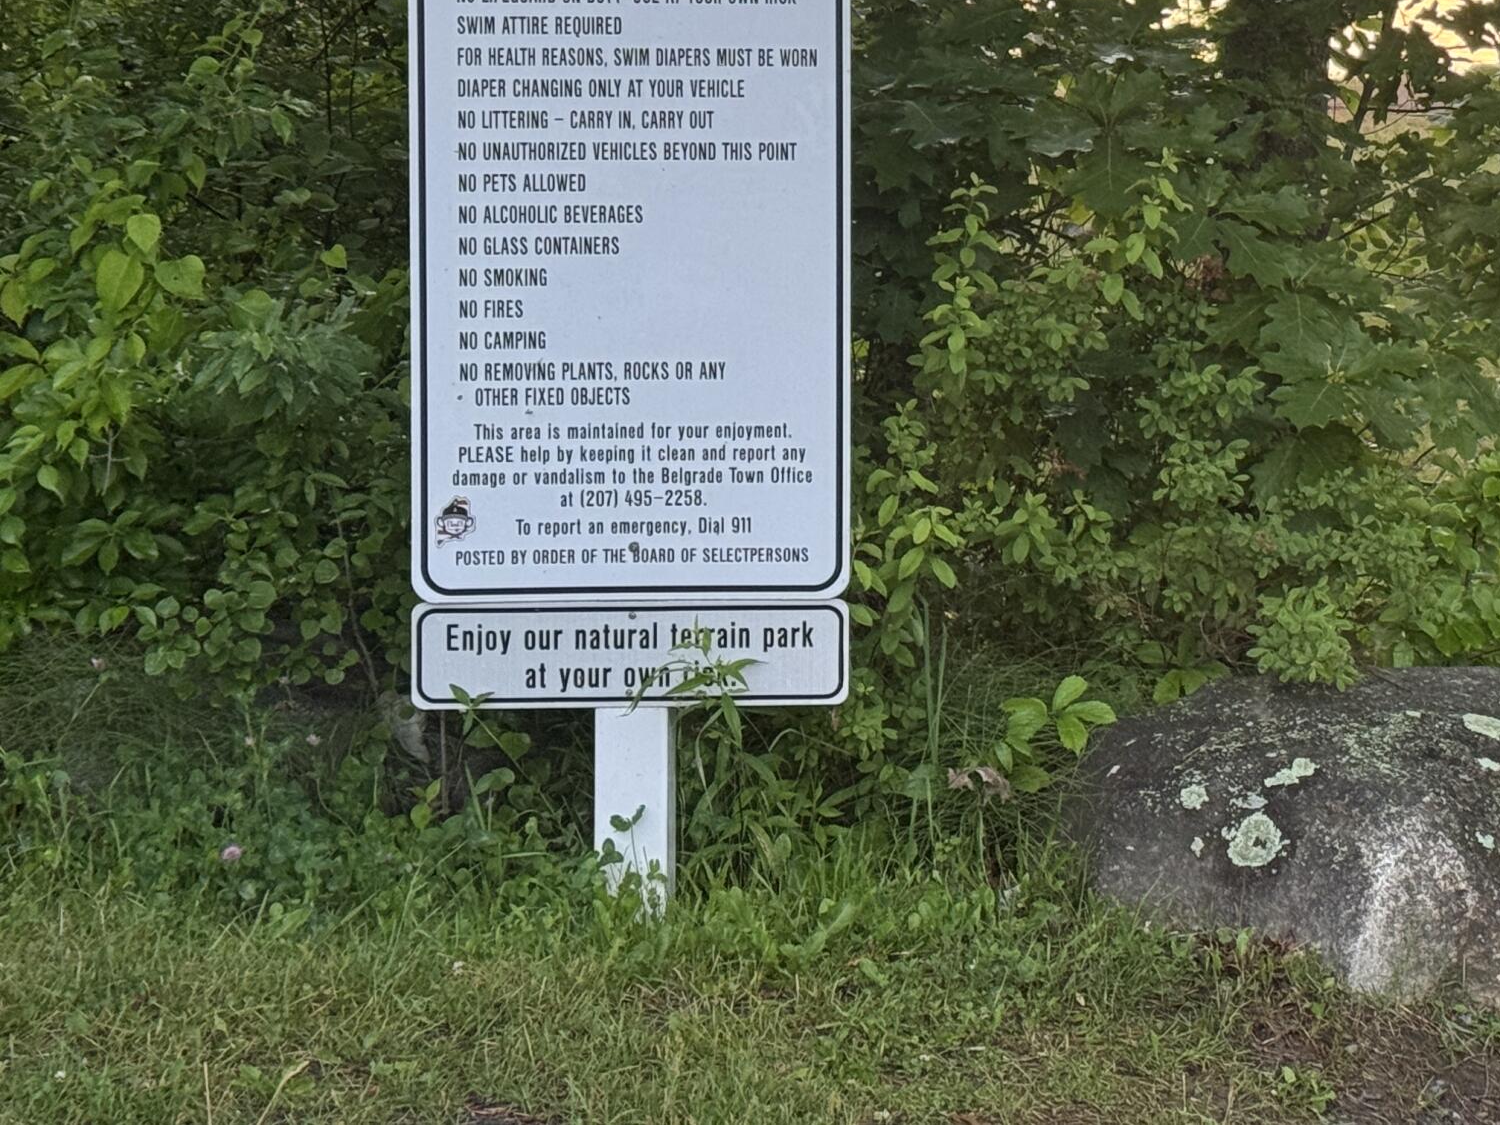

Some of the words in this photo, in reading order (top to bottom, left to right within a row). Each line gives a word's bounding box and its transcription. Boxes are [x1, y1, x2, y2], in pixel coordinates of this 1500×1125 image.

[457, 15, 496, 35] SWIM
[501, 15, 549, 35] ATTIRE
[554, 15, 622, 38] REQUIRED
[457, 47, 482, 67] FOR
[488, 47, 536, 67] HEALTH
[542, 47, 608, 67] REASONS,
[613, 47, 650, 67] SWIM
[655, 47, 711, 67] DIAPERS
[716, 48, 753, 67] MUST
[758, 48, 774, 67] BE
[779, 48, 818, 67] WORN
[457, 78, 506, 98] DIAPER
[512, 78, 582, 98] CHANGING
[588, 78, 622, 98] ONLY
[627, 78, 644, 98] AT
[648, 78, 684, 98] YOUR
[689, 79, 745, 98] VEHICLE
[457, 110, 476, 130] NO
[481, 110, 549, 130] LITTERING
[570, 110, 613, 129] CARRY
[618, 110, 636, 130] IN,
[641, 110, 684, 129] CARRY
[689, 110, 715, 130] OUT
[458, 142, 477, 161] NO
[482, 141, 587, 161] UNAUTHORIZED
[592, 141, 658, 161] VEHICLES
[663, 141, 717, 161] BEYOND
[721, 141, 753, 161] THIS
[758, 142, 798, 161] POINT
[458, 173, 477, 193] NO
[483, 173, 517, 193] PETS
[522, 173, 586, 193] ALLOWED
[458, 205, 477, 224] NO
[483, 204, 558, 224] ALCOHOLIC
[563, 204, 644, 224] BEVERAGES
[458, 236, 477, 256] NO
[483, 236, 529, 256] GLASS
[534, 236, 620, 256] CONTAINERS
[459, 268, 478, 287] NO
[483, 267, 548, 287] SMOKING
[459, 299, 478, 319] NO
[484, 299, 524, 319] FIRES
[459, 331, 478, 350] NO
[484, 330, 546, 350] CAMPING
[459, 362, 478, 382] NO
[484, 361, 556, 382] REMOVING
[561, 361, 618, 382] PLANTS,
[623, 361, 670, 381] ROCKS
[675, 361, 693, 380] OR
[699, 361, 726, 380] ANY
[475, 387, 519, 407] OTHER
[525, 387, 565, 406] FIXED
[570, 386, 631, 406] OBJECTS
[473, 423, 504, 441] This
[510, 426, 541, 440] area
[547, 422, 561, 440] is
[567, 422, 644, 440] maintained
[651, 422, 672, 439] for
[678, 425, 709, 442] your
[715, 421, 792, 442] enjoyment.
[458, 445, 514, 464] PLEASE
[520, 445, 550, 465] help
[557, 445, 574, 465] by
[580, 445, 635, 465] keeping
[641, 444, 651, 462] it
[658, 444, 695, 462] clean
[702, 444, 726, 461] and
[732, 444, 776, 464] report
[782, 447, 806, 464] any
[452, 469, 506, 489] damage
[512, 472, 528, 486] or
[534, 467, 606, 485] vandalism
[612, 468, 626, 485] to
[632, 467, 655, 485] the
[661, 466, 723, 487] Belgrade
[728, 466, 764, 484] Town
[770, 466, 813, 484] Office
[560, 491, 573, 508] at
[580, 488, 618, 509] (207)
[515, 518, 531, 536] To
[537, 518, 582, 538] report
[588, 521, 604, 535] an
[610, 520, 692, 537] emergency,
[698, 516, 725, 535] Dial
[731, 516, 752, 534] 911
[455, 549, 505, 566] POSTED
[511, 549, 527, 565] BY
[532, 548, 575, 565] ORDER
[581, 548, 598, 564] OF
[602, 548, 626, 564] THE
[632, 547, 676, 564] BOARD
[680, 547, 697, 563] OF
[702, 547, 809, 563] SELECTPERSONS
[446, 623, 512, 656] Enjoy
[524, 629, 563, 651] our
[575, 621, 658, 650] natural
[763, 620, 814, 653] park
[525, 662, 546, 689] at
[559, 667, 612, 693] your
[624, 666, 673, 688] own
